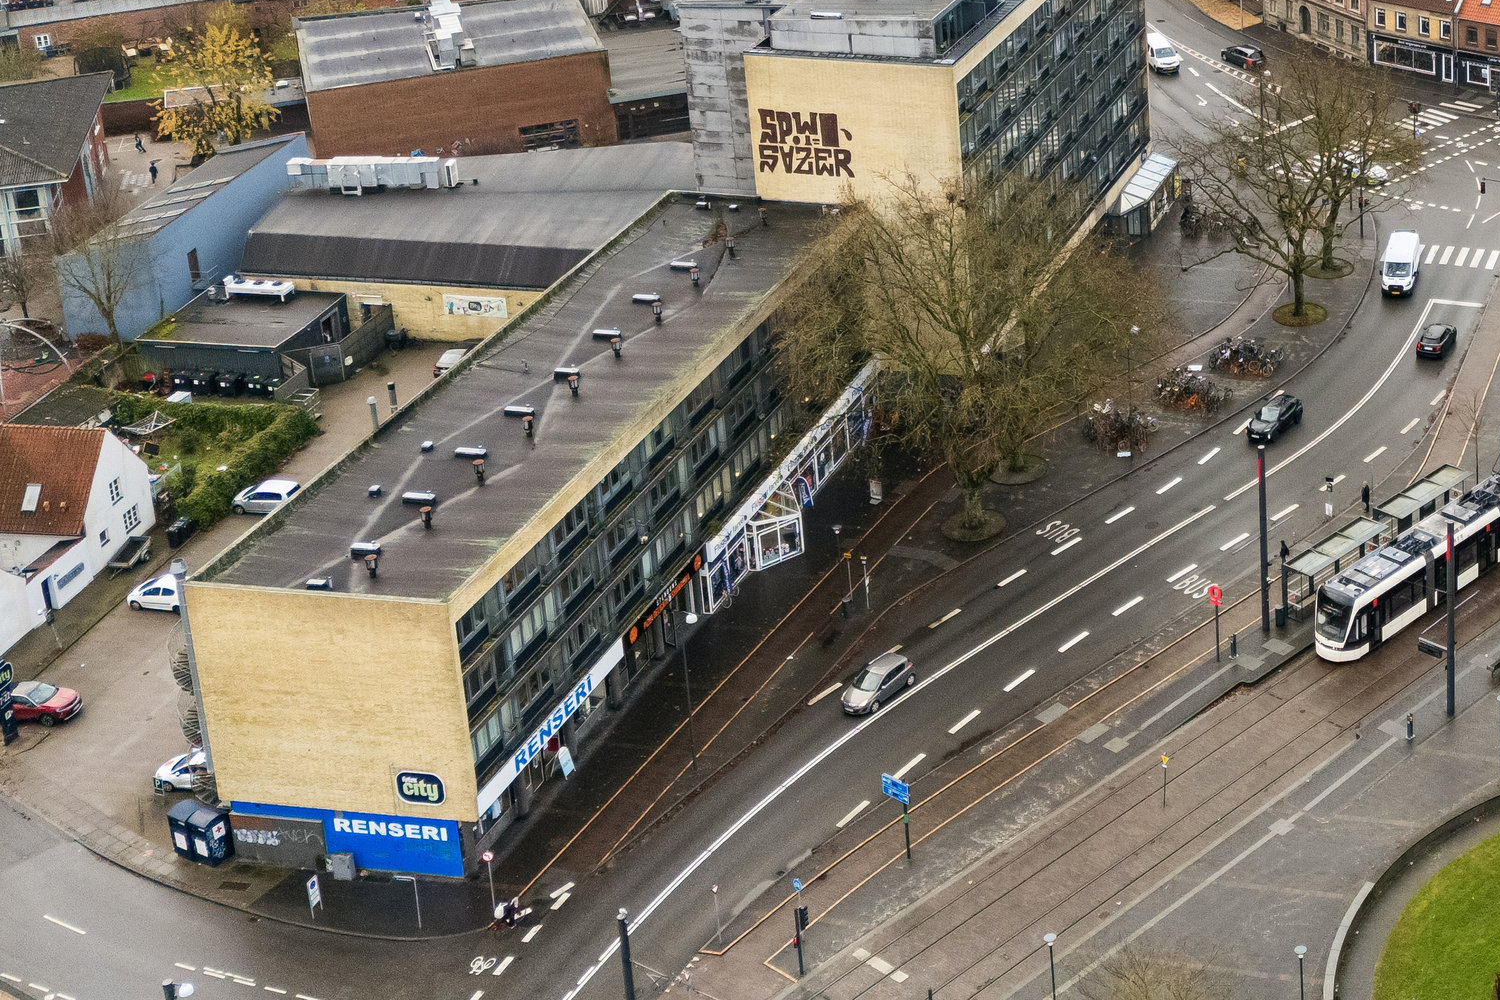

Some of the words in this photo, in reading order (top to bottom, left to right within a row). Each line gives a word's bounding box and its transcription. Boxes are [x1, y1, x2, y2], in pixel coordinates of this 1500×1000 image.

[1035, 520, 1080, 543] BUS
[1172, 574, 1219, 599] BUS
[514, 673, 592, 774] RENSERI
[402, 780, 439, 802] city
[333, 818, 448, 842] RENSERI
